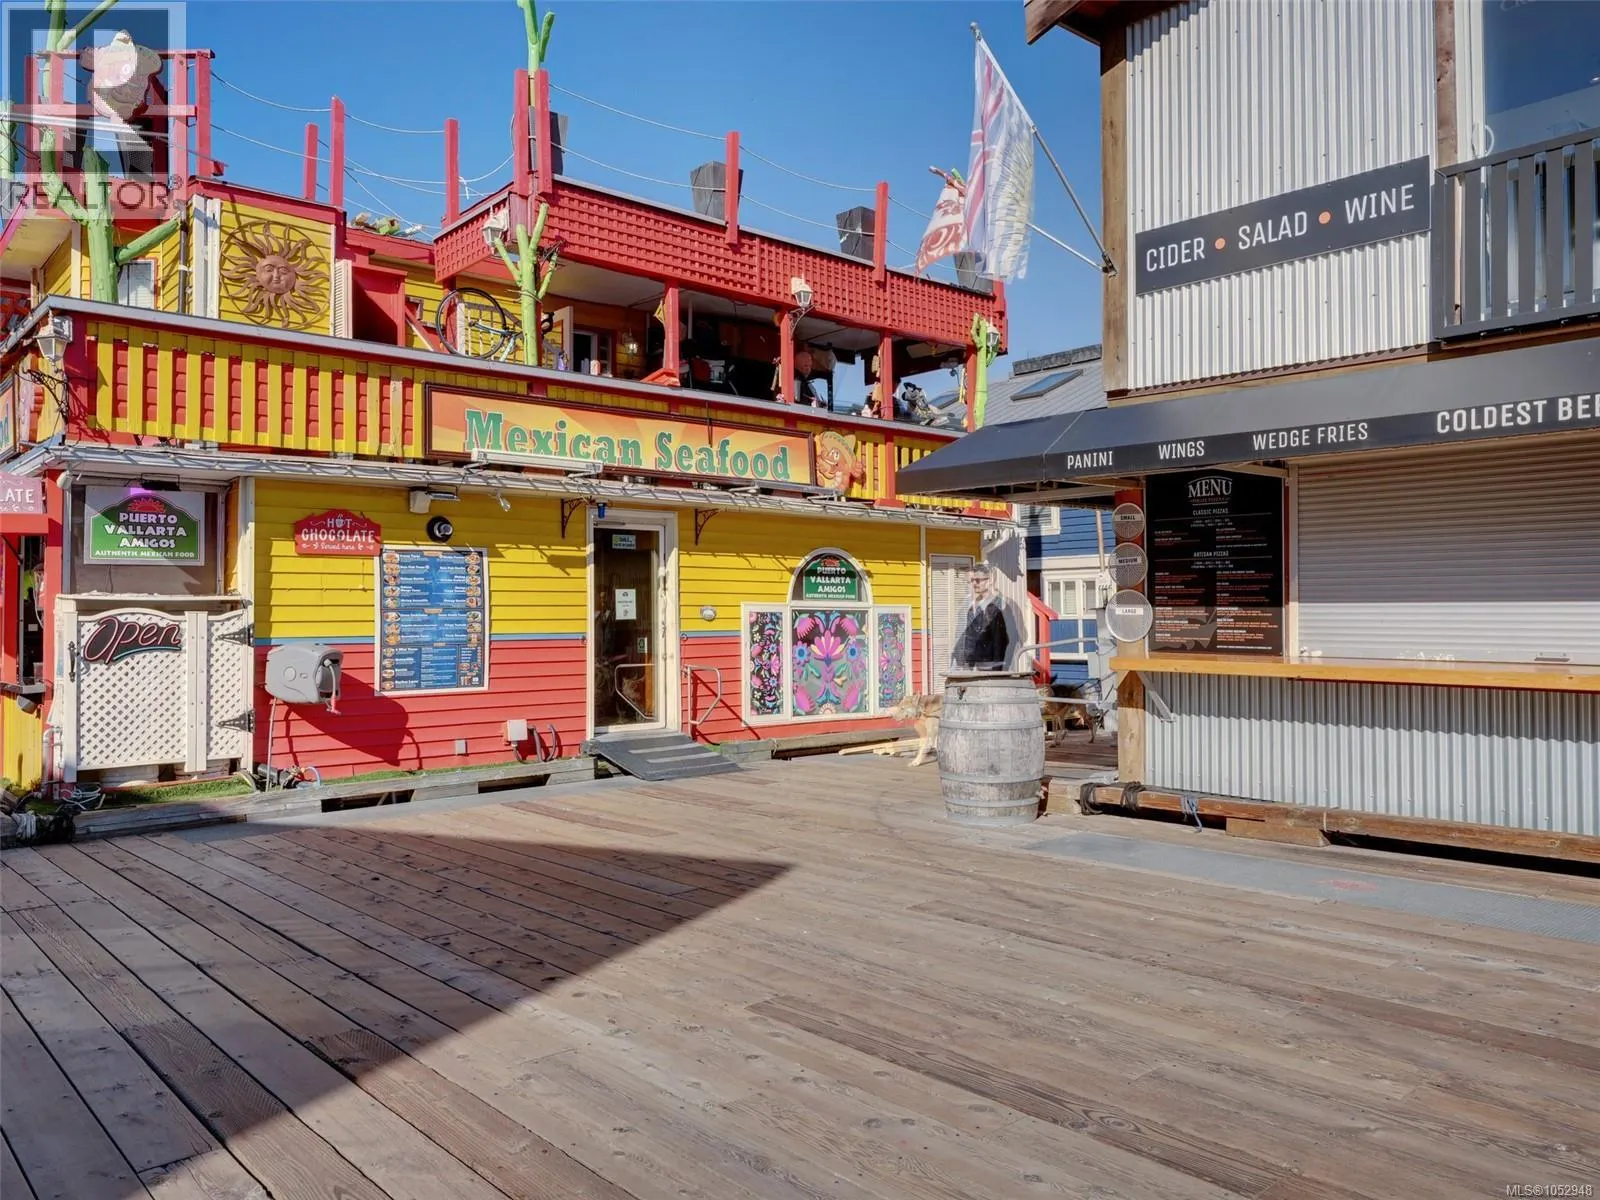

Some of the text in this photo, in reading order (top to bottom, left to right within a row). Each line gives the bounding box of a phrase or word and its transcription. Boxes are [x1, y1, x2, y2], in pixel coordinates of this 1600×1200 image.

[1146, 184, 1415, 272] CIDER SALAD WINE
[1436, 400, 1547, 434] COLDEST
[1252, 422, 1368, 451] WEDGE FRIES
[464, 408, 791, 481] Mexican Seafood
[1158, 440, 1205, 460] WINGS
[1067, 451, 1113, 470] PANINI
[1187, 479, 1233, 498] MENU
[119, 512, 178, 524] PUERTO
[1192, 508, 1212, 516] CLASSIC
[104, 524, 187, 537] VALLARTA
[327, 518, 353, 529] HOT
[301, 528, 376, 543] CHOCOLATE
[119, 537, 176, 549] AMIGOS
[140, 550, 174, 558] MEXICAN
[816, 566, 847, 575] PUERTO
[810, 576, 851, 584] VALLARTA
[817, 585, 846, 593] AMIGOS
[83, 615, 181, 665] Open
